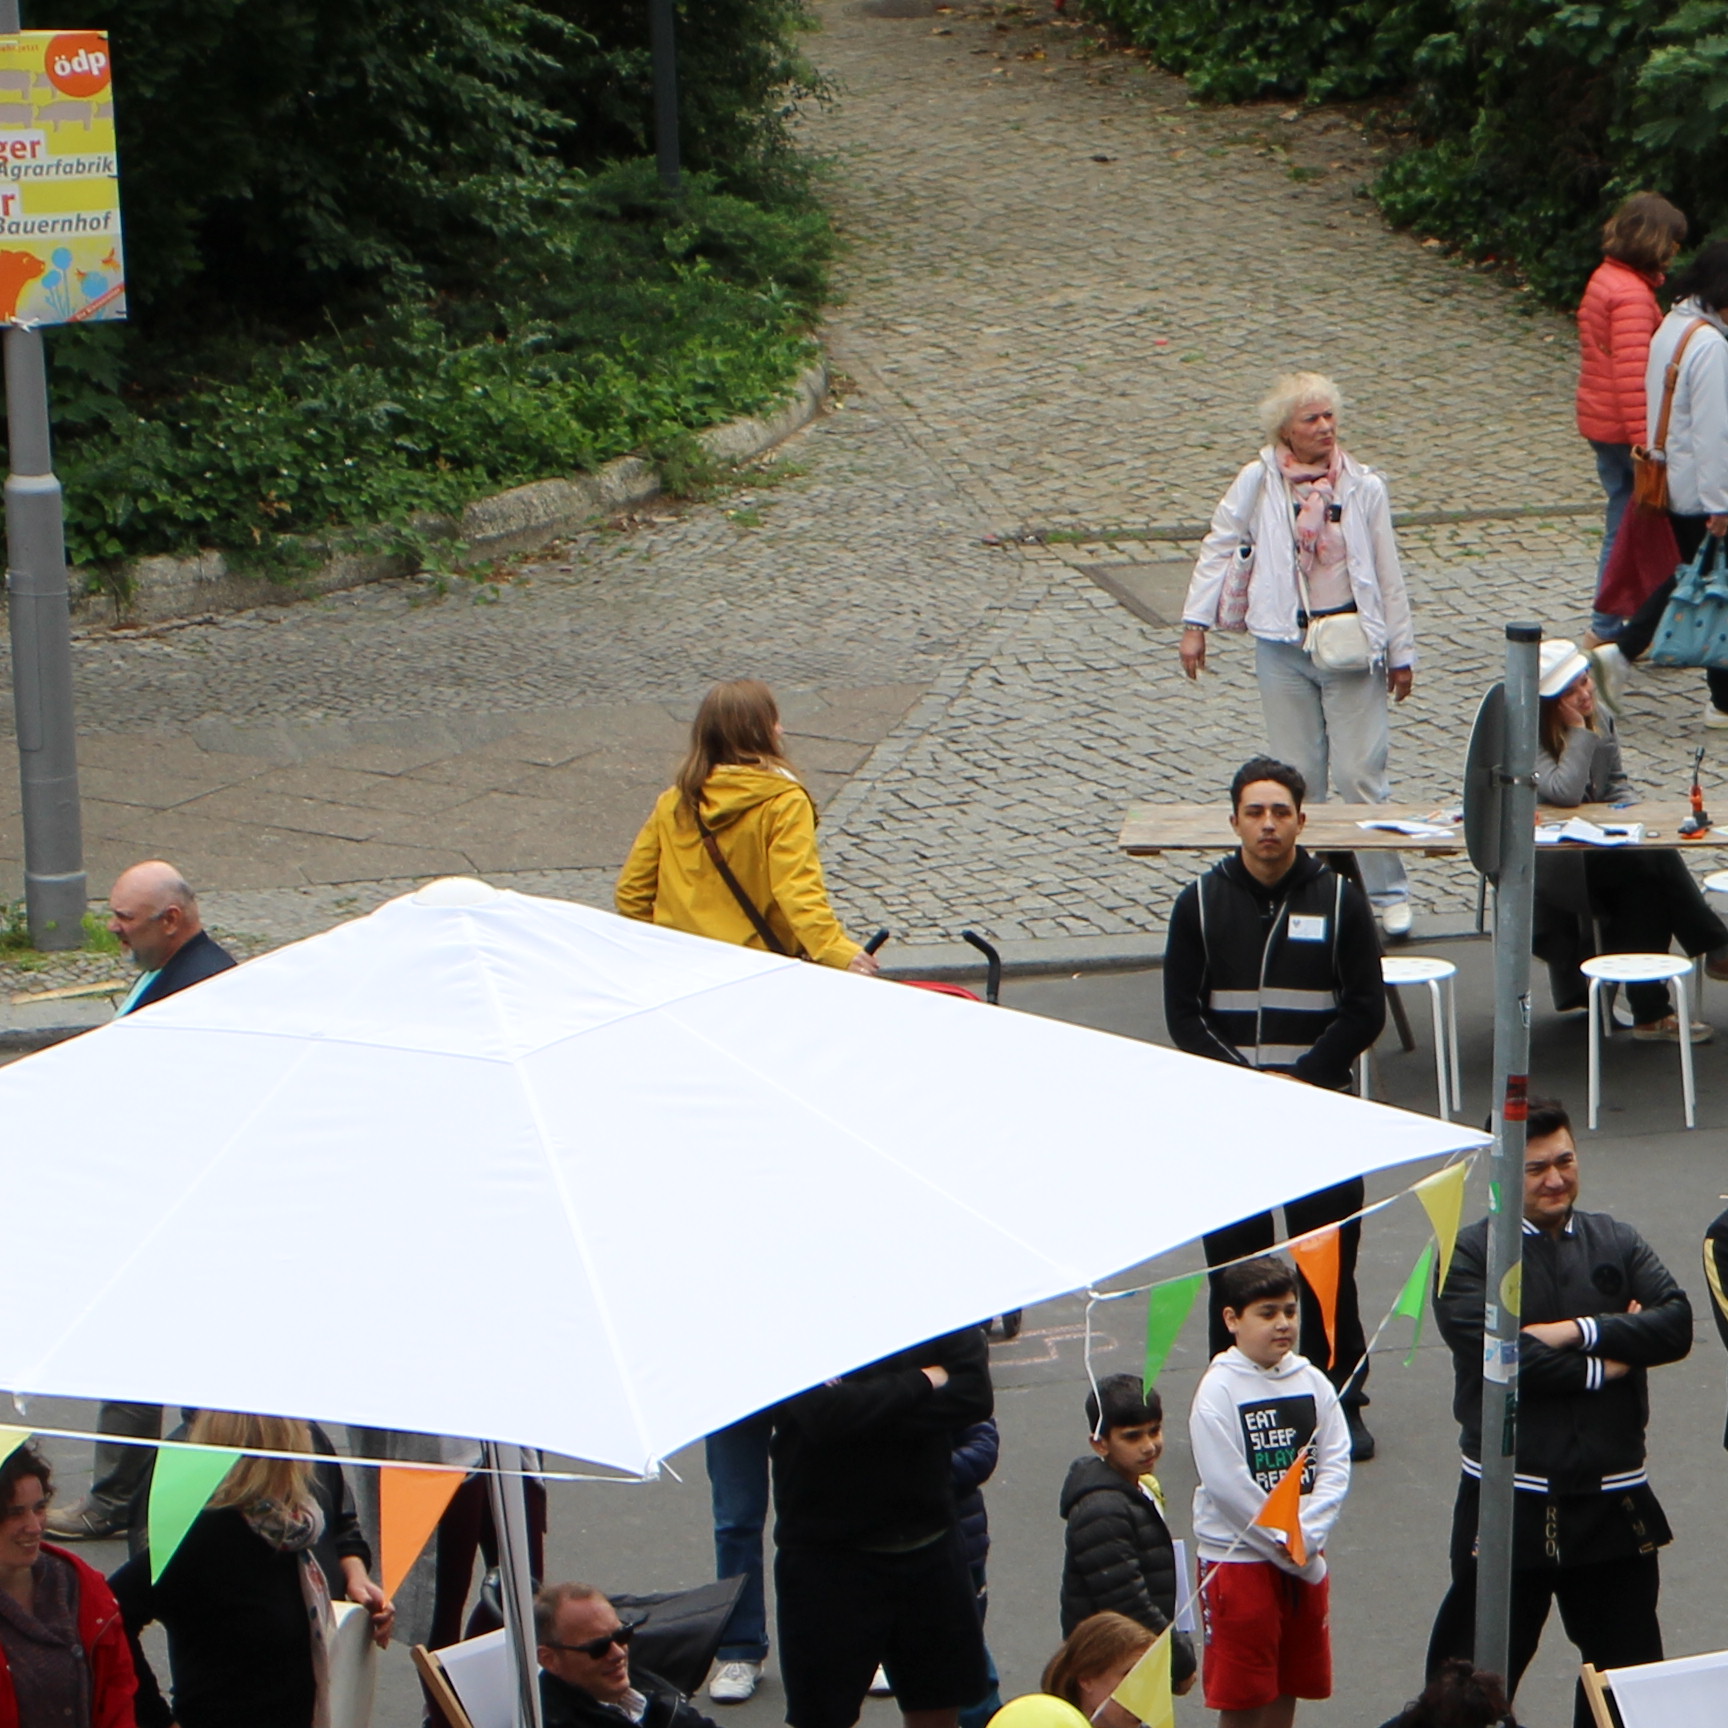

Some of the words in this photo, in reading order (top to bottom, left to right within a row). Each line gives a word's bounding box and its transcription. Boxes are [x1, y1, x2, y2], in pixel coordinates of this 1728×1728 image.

[54, 48, 107, 77] ödp
[1244, 1409, 1277, 1431] EAT
[1250, 1427, 1297, 1451] SLEEP
[1255, 1447, 1296, 1471] PLAY
[1255, 1465, 1317, 1490] REPAT
